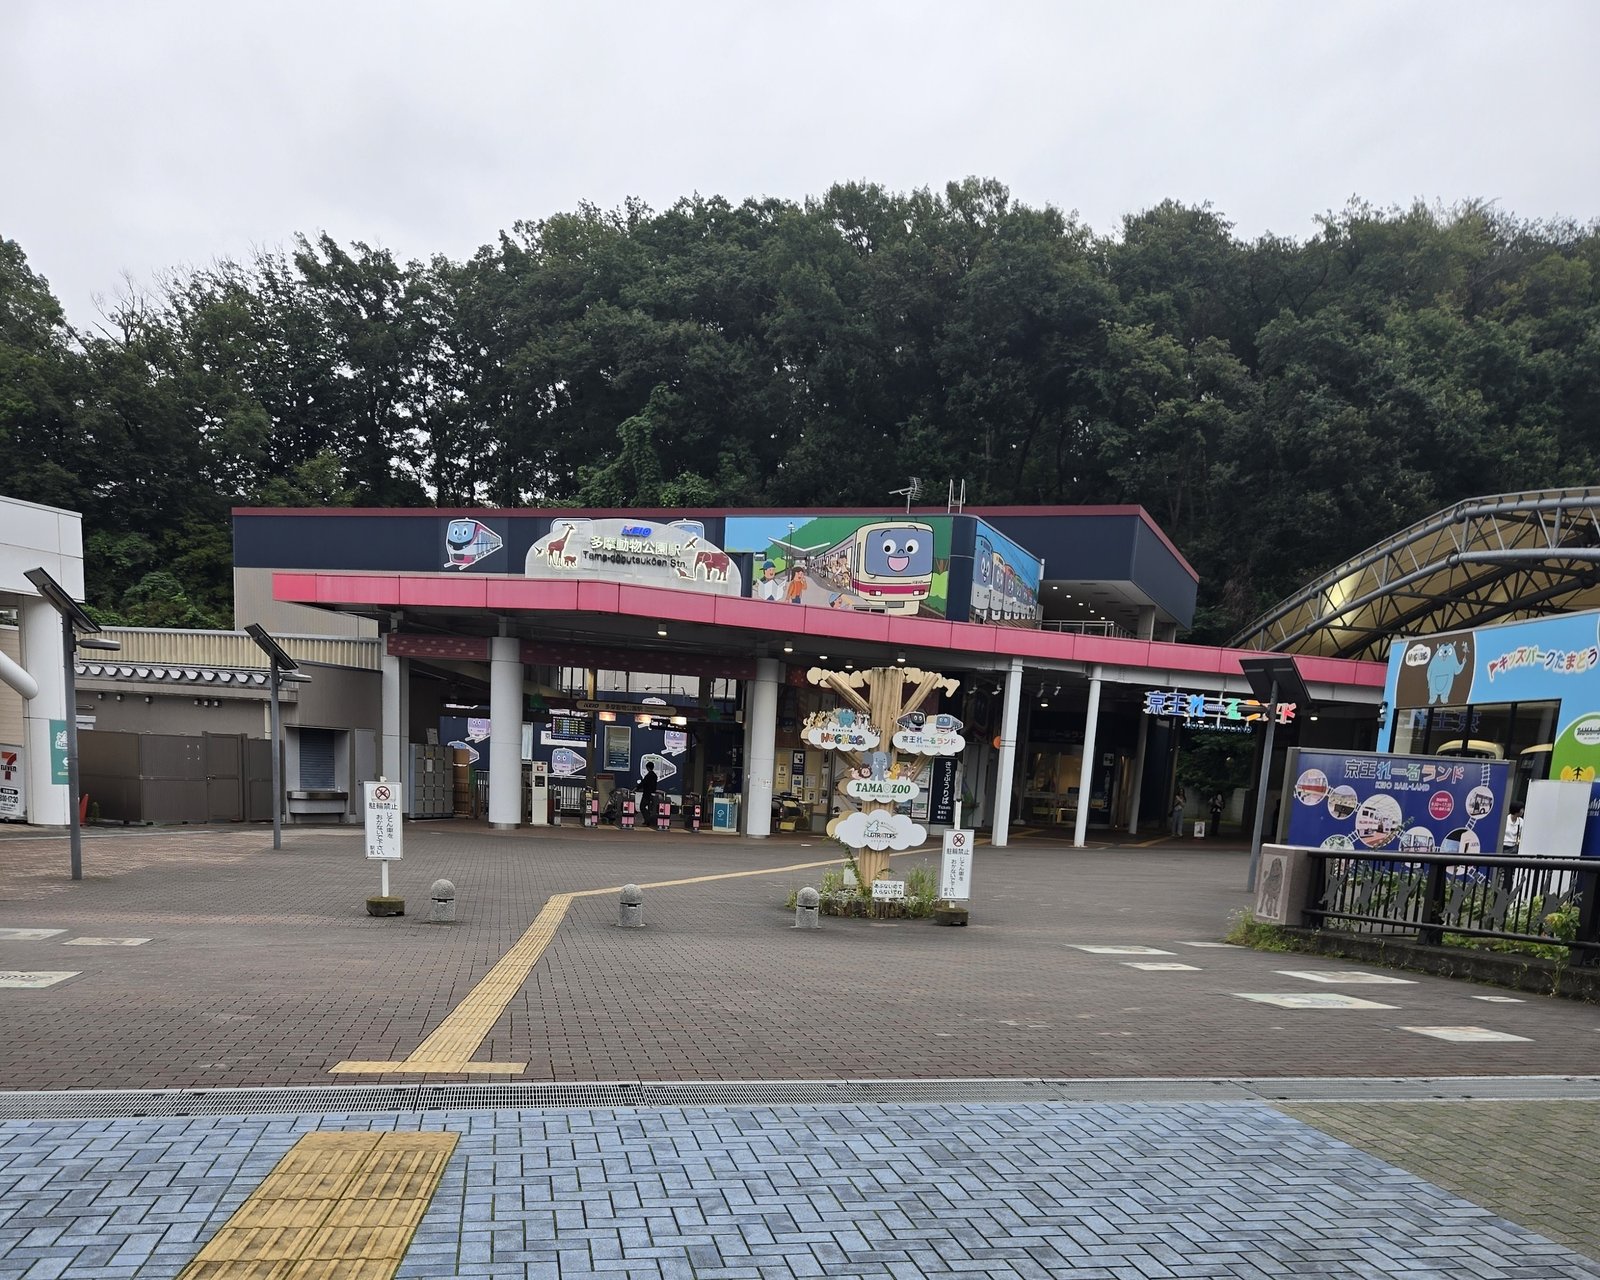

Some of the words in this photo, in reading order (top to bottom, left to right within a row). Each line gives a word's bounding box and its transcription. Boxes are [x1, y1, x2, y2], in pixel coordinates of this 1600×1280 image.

[621, 526, 652, 538] KEIO
[590, 536, 681, 556] 多摩動物公園駅
[1498, 648, 1598, 670] キッズパークたまどう
[902, 735, 957, 746] 京王れーるランド
[1344, 759, 1465, 784] 京王れーるランド
[856, 783, 883, 793] TAMA
[891, 784, 911, 794] ZOO
[942, 761, 952, 804] きっぷうりば
[368, 802, 398, 810] 駐輪禁止
